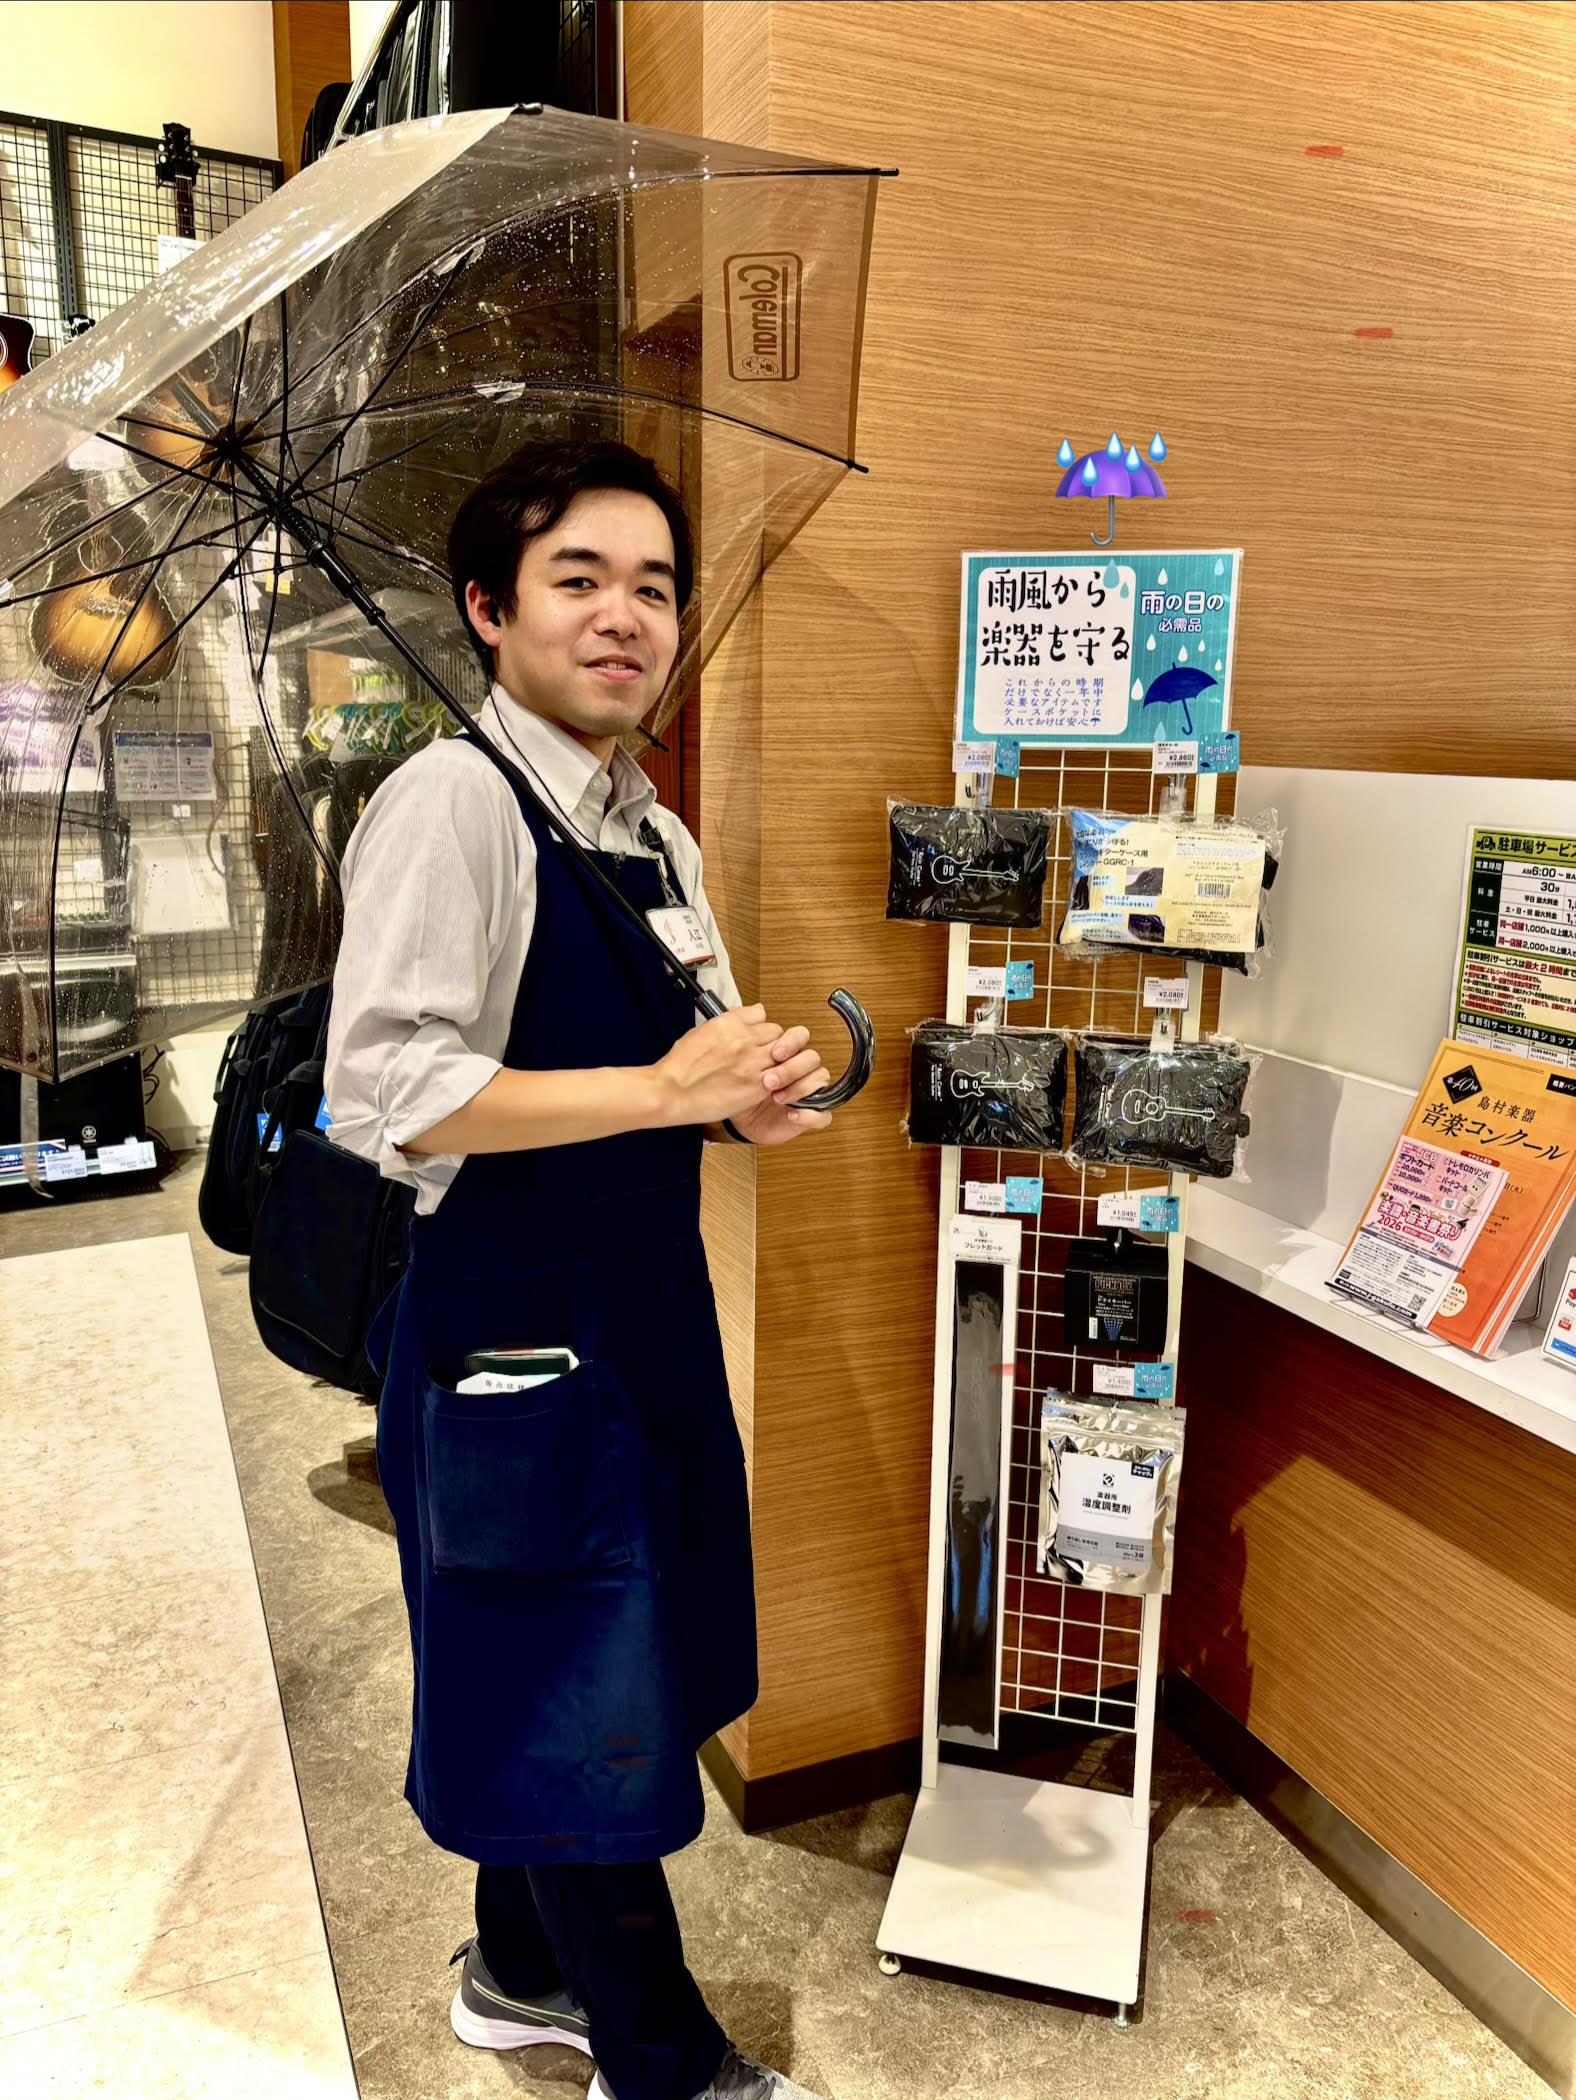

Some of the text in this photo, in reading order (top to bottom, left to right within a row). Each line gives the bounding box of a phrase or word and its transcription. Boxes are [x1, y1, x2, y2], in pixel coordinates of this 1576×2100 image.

[987, 569, 1106, 613] 雨風から
[1140, 590, 1225, 616] 雨の日の
[1157, 617, 1203, 633] 必需品
[980, 621, 1130, 667] 楽器を守る
[1004, 678, 1104, 688] これからの時期
[1004, 688, 1103, 697] だけでなく一年中
[1004, 697, 1103, 707] 必要なアイテムです
[1003, 707, 1102, 717] ケースポケットに
[1103, 858, 1134, 866] GGRC-1
[1477, 1095, 1536, 1124] 島村楽器
[1421, 1102, 1569, 1161] 音楽コンクール
[1377, 1214, 1402, 1232] 2026
[1082, 1497, 1132, 1515] 湿度調整剤
